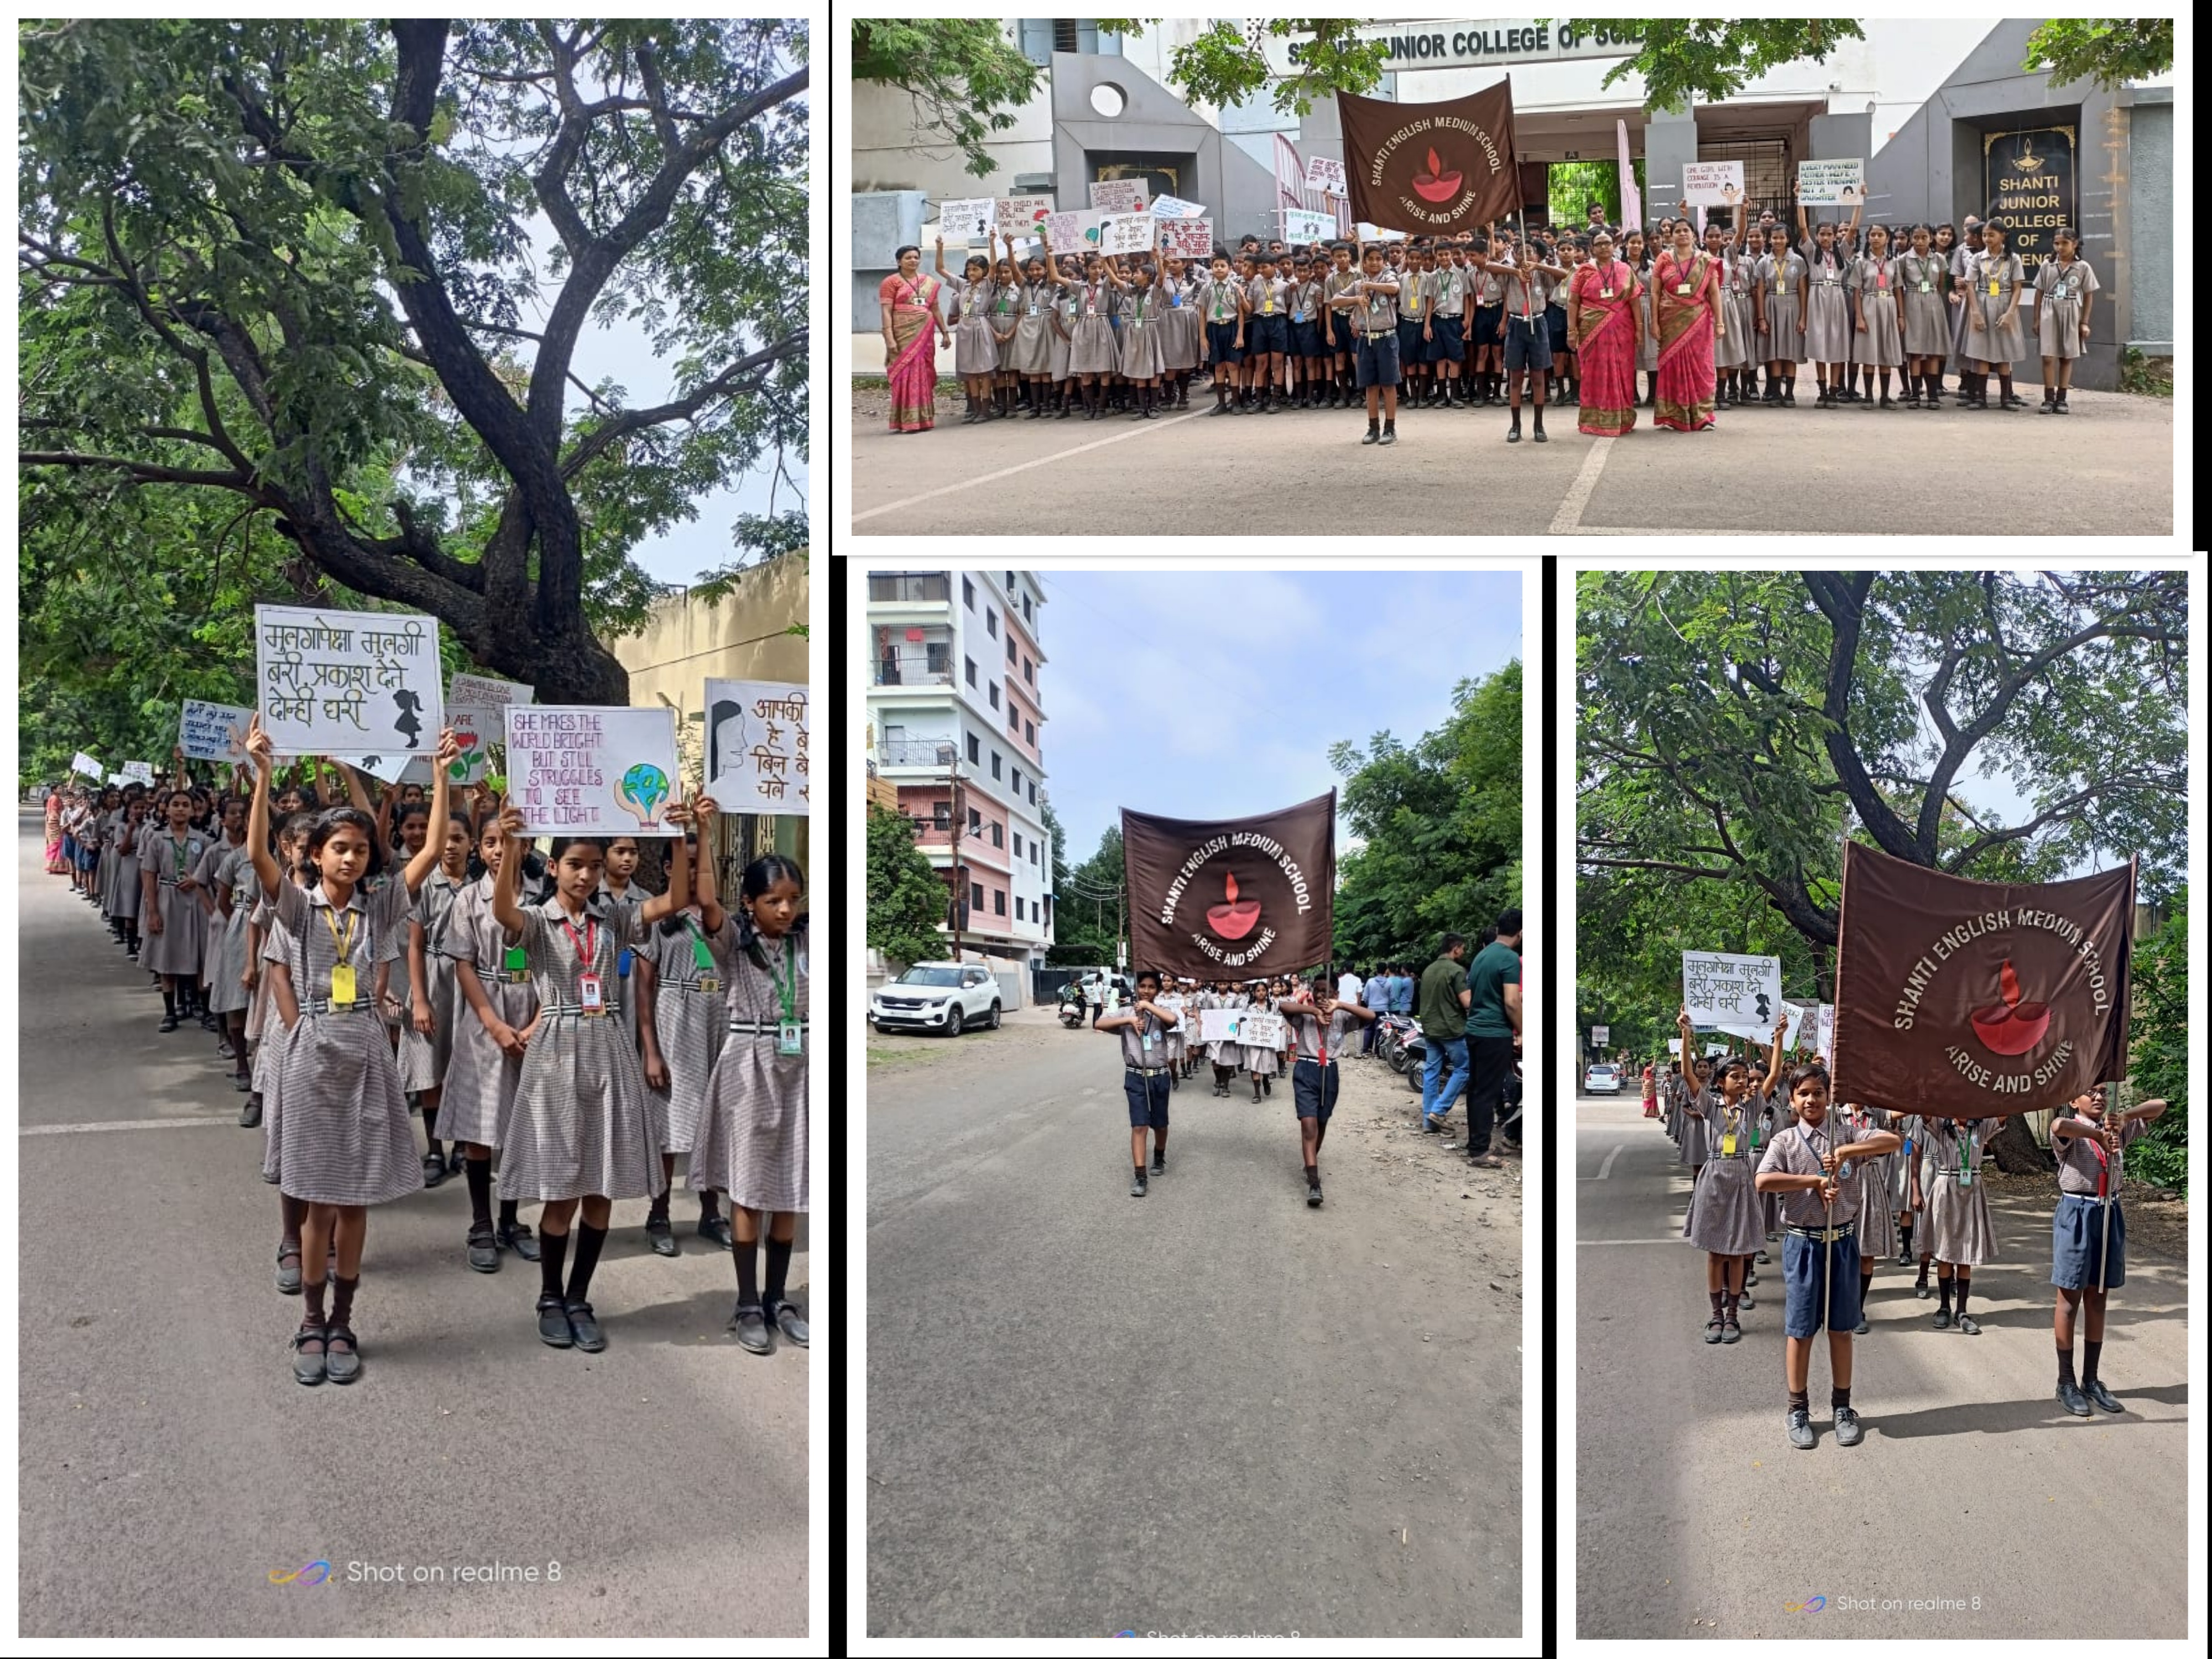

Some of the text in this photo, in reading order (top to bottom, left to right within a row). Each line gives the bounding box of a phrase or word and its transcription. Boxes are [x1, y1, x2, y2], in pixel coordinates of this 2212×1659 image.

[1453, 27, 1548, 55] COLLEGE
[1372, 148, 1390, 186] SHANTI
[1386, 119, 1431, 150] ENGLISH
[1435, 117, 1479, 137] MEDIUM
[1475, 131, 1501, 175] SCHOOL
[2000, 175, 2059, 191] SHANTI
[1399, 190, 1475, 224] ARISE AND SHINE
[1999, 195, 2060, 210] JUNIOR
[1995, 214, 2067, 228] OLLEGE
[2018, 234, 2039, 247] OF
[264, 616, 426, 658] मुलगापेक्षा मुलगी
[307, 663, 378, 694] प्रकाश
[376, 659, 409, 688] देते
[323, 690, 371, 731] घरी
[453, 714, 473, 725] ARE
[514, 714, 538, 731] SHE
[541, 714, 575, 731] MAKES
[577, 714, 603, 731] THE
[512, 733, 603, 749] WORLD BRIGHT
[532, 750, 594, 768] BUT STILL
[749, 745, 790, 775] बिन
[529, 769, 603, 786] STRUGGLES
[757, 773, 790, 800] चले
[519, 788, 581, 805] TO SEE
[521, 807, 600, 824] THE LIGHT
[1162, 832, 1311, 924] SHANTI ENGLISH MEDIUM SCHOOL
[1192, 927, 1276, 966] ARISE AND SHINE
[1687, 956, 1775, 978] मुलगापेक्षा मुलगी
[1895, 908, 2110, 1030] SHANTI ENGLISH MEDIUM SCHOOL
[1710, 979, 1748, 996] प्रकाश
[1747, 977, 1764, 993] देते
[1719, 993, 1744, 1014] घरी
[1945, 1039, 2073, 1093] ARISE AND SHINE
